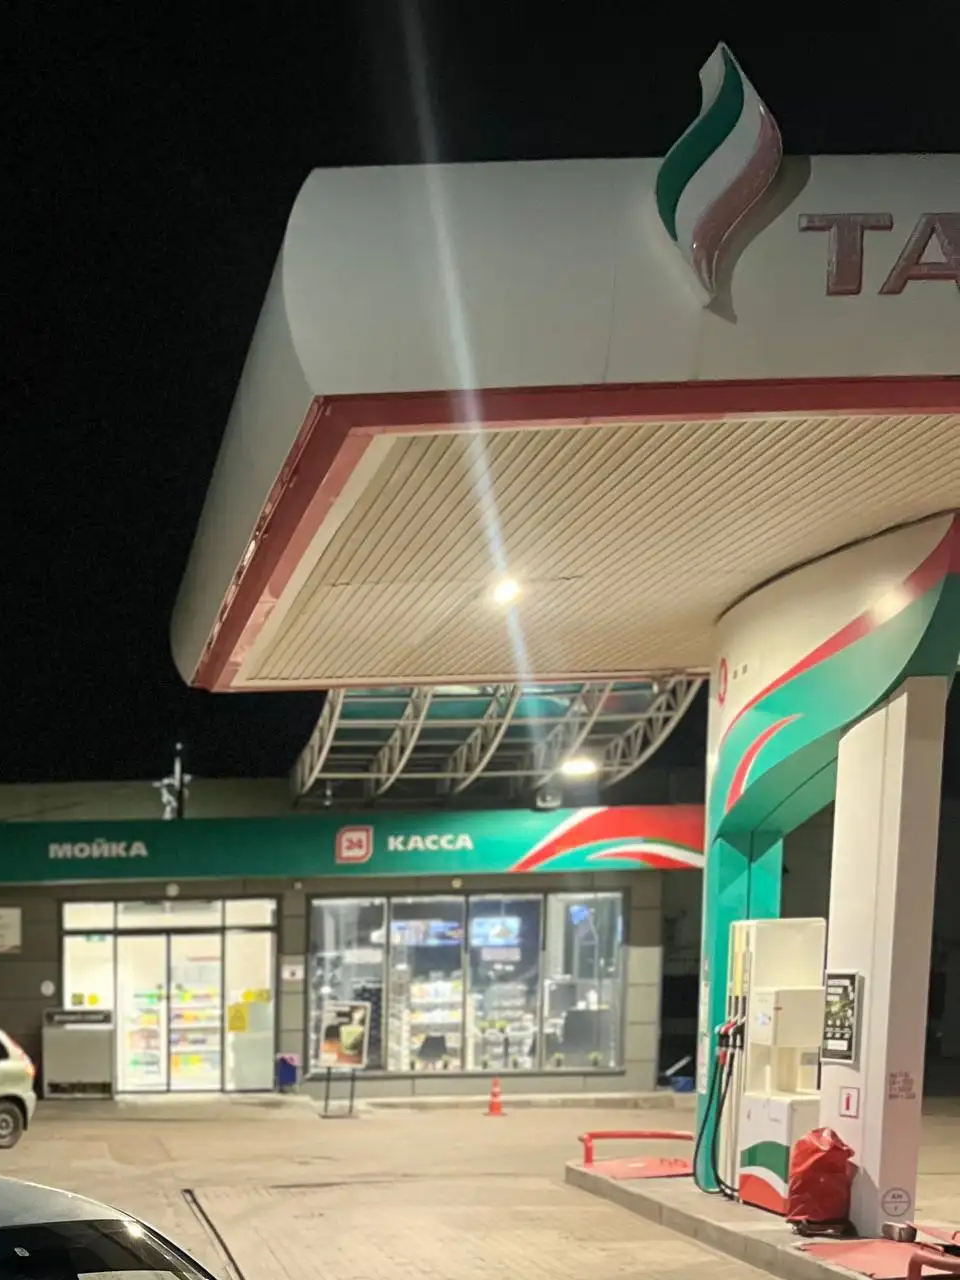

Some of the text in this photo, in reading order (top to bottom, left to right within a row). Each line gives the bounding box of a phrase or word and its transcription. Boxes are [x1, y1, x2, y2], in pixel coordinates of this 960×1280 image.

[48, 837, 149, 859] МОЙКА
[344, 836, 364, 851] 24
[386, 832, 475, 852] КАССА
